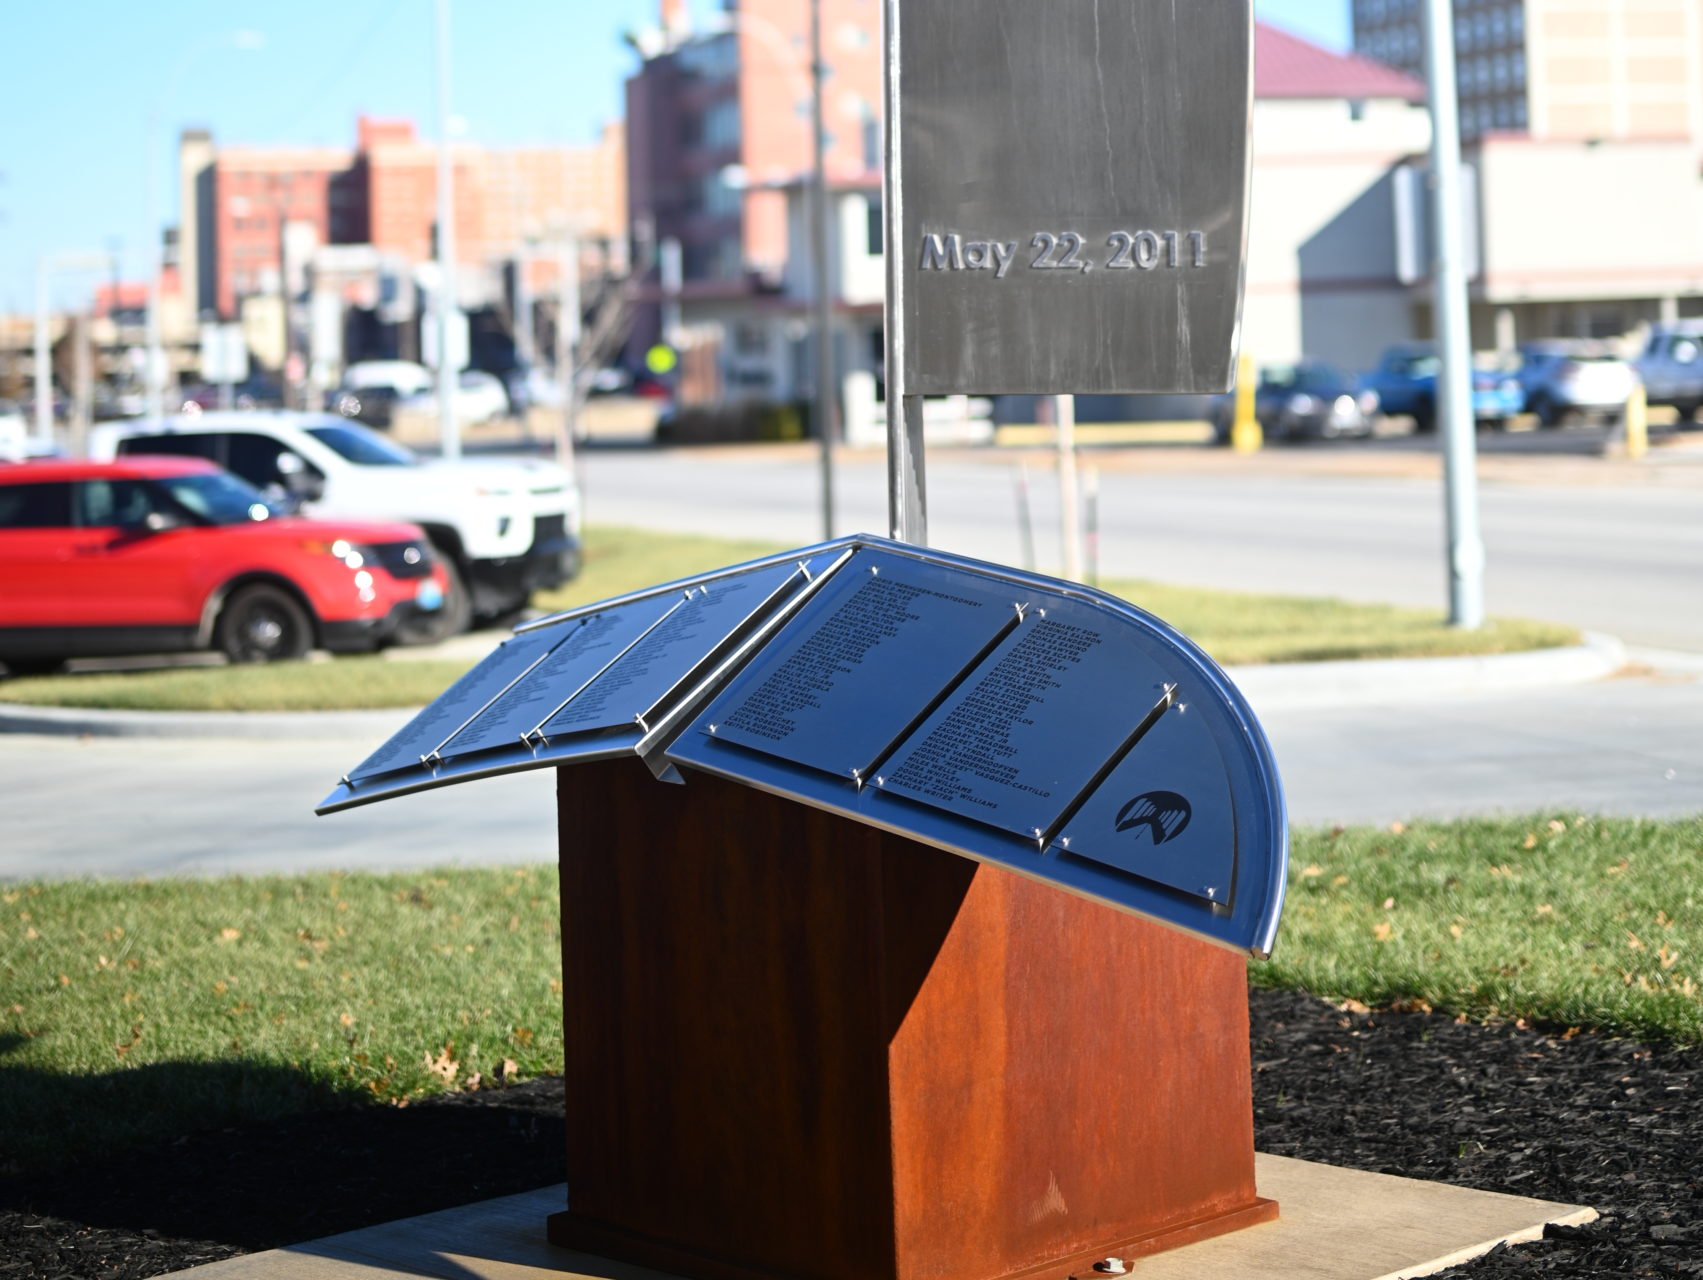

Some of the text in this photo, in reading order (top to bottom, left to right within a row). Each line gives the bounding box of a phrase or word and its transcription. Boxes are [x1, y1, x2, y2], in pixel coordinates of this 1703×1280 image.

[922, 231, 1208, 277] May 22, 2011
[1029, 628, 1091, 647] GRACE SANDERS
[1034, 623, 1102, 644] VIRGINIA SALMON
[1039, 618, 1100, 637] MARGARET ROW
[1016, 642, 1081, 663] FRANCES SCATES
[1020, 637, 1079, 656] TONJA SAWYER
[1025, 632, 1087, 652] THOMAS SARINO
[1001, 656, 1047, 672] JUDY SMITH
[1006, 651, 1067, 671] DANIEL SHIRLEY
[1011, 647, 1062, 664] GLADYS SEAY
[988, 671, 1047, 690] SHYRELL SMITH
[992, 666, 1062, 688] NICHOLAUS SMITH
[997, 661, 1052, 679] LUTHER SMITH
[978, 680, 1046, 703] BETTY STOGSDILL
[983, 675, 1032, 692] LOIS SPARKS
[963, 695, 1024, 716] GREGAN SWEET
[973, 685, 1031, 705] RALPH STOVER
[979, 693, 1028, 710] STRICKLAND
[949, 710, 1011, 732] HEATHER TERRY
[954, 705, 1014, 726] KAYLEIGH TEAL
[958, 700, 1034, 725] JEFFERSON TAYLOR
[939, 720, 962, 730] JOHN
[962, 727, 998, 740] THOMAS,
[944, 715, 1010, 738] SANDRA THOMAS
[925, 735, 997, 760] MICHAEL TYNDALL
[930, 730, 1013, 758] MARGARET ANN TUTT
[935, 725, 1019, 754] ZACHARY TREADWELL
[905, 755, 958, 775] MILES WELLS
[914, 745, 1016, 780] JOSHUA VANDERHOOFVEN
[920, 740, 1020, 774] DARIAN VANDERHOOFVEN
[895, 766, 973, 794] DOUGLAS WILLIAMS
[900, 761, 961, 783] TIERA WHITLEY
[909, 750, 1051, 798] MIGUEL "MIKEY" VASQUEZ-CASTILLO
[885, 776, 955, 801] CHARLES WRITER
[890, 771, 999, 809] ZACHARY "ZACH" WILLIAMS
